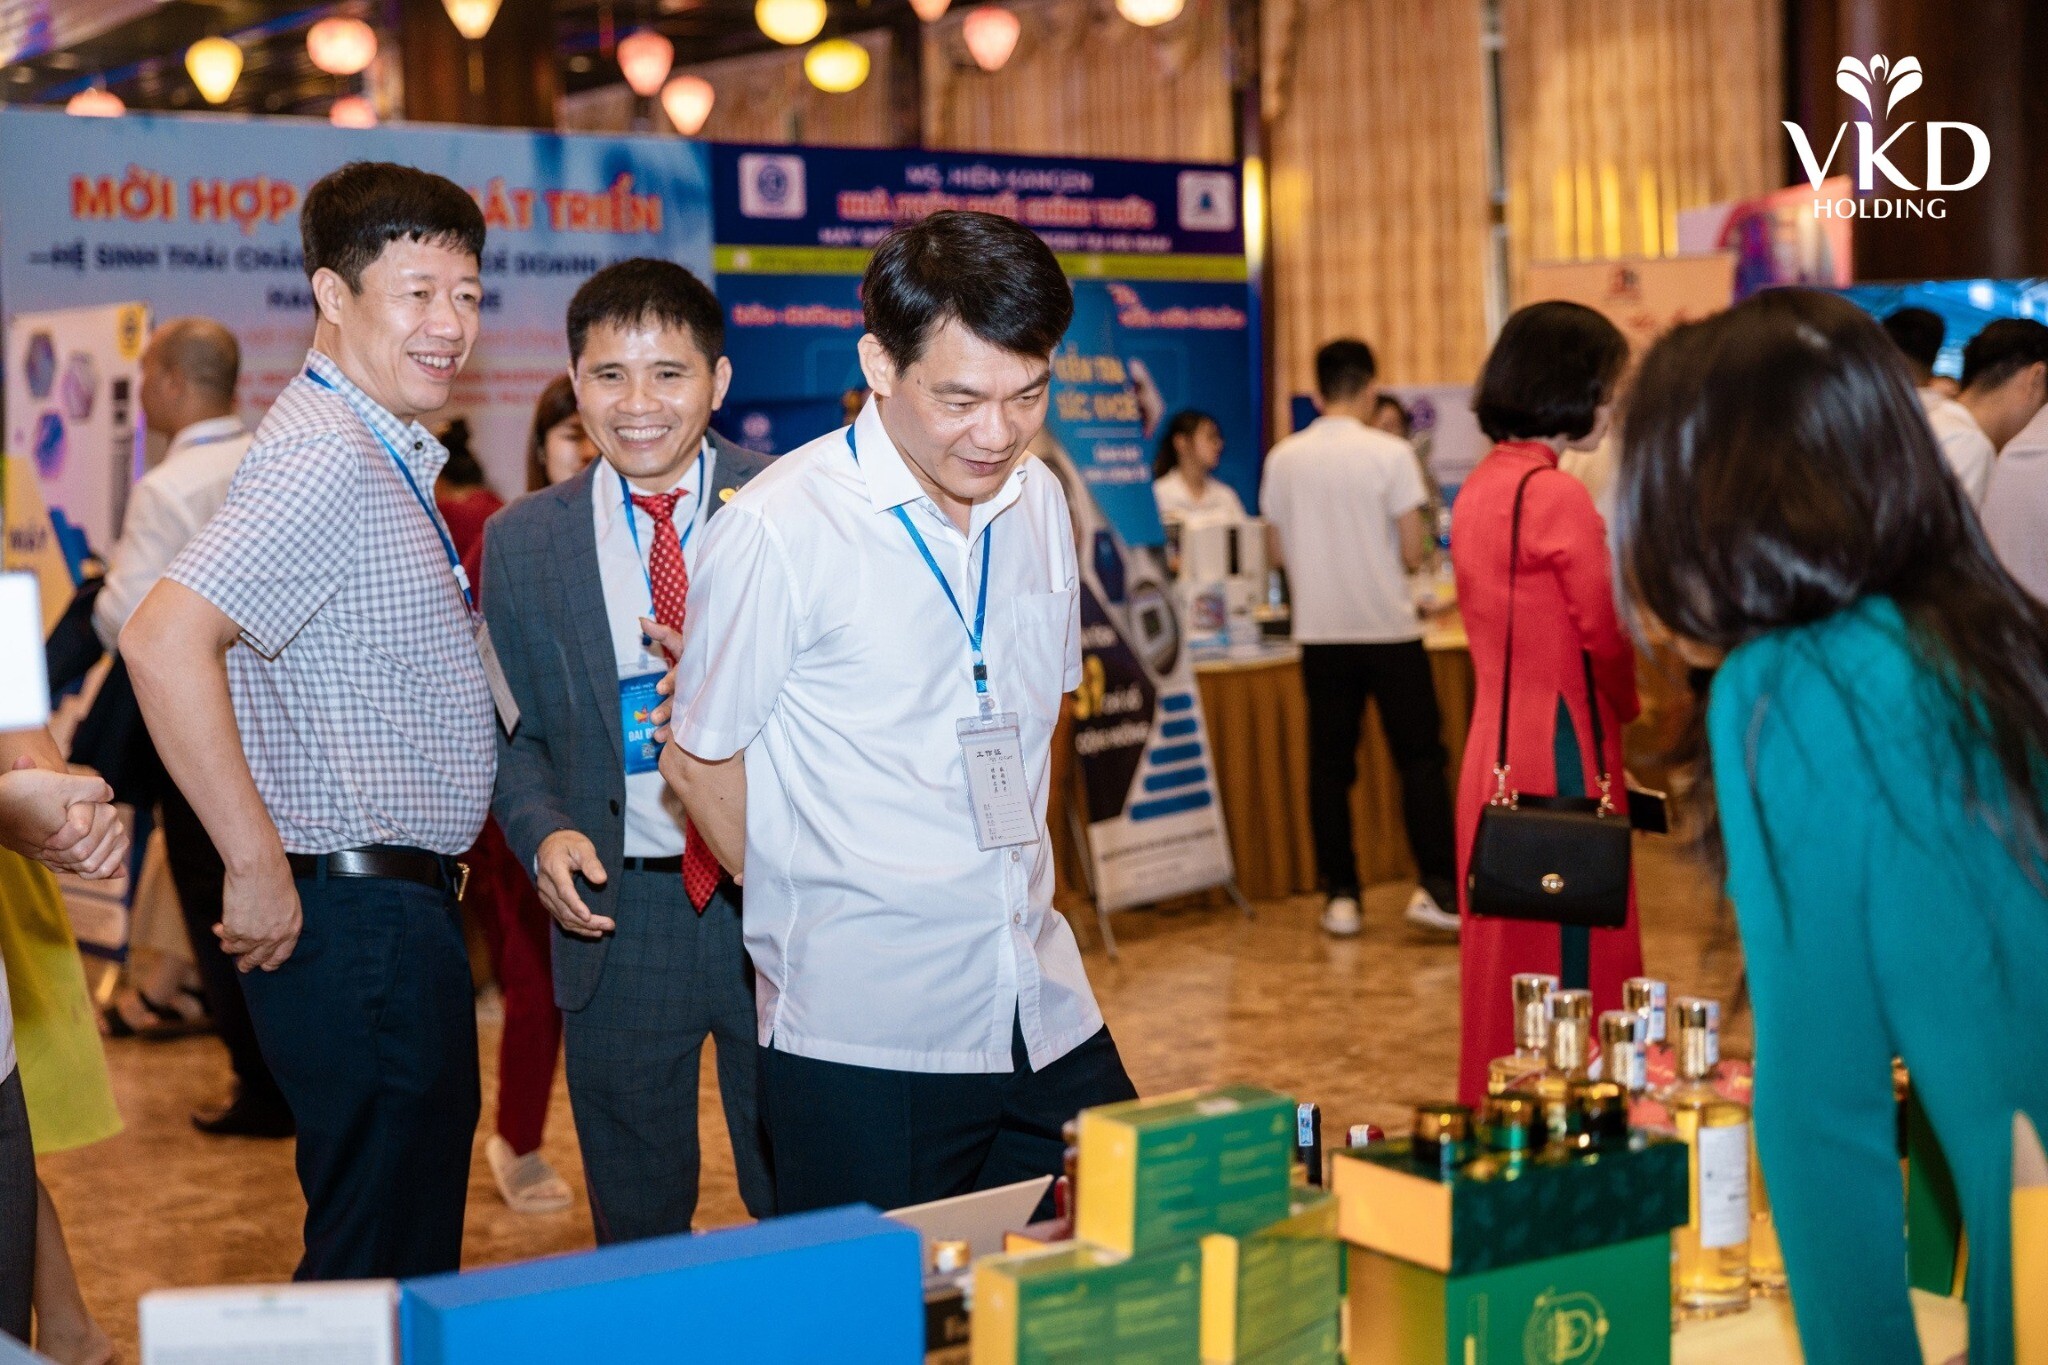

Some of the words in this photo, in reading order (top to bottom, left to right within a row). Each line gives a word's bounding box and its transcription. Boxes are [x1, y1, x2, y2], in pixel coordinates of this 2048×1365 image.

[71, 163, 176, 221] MỜI
[189, 174, 298, 236] HỢP
[545, 172, 663, 234] TRIỂN
